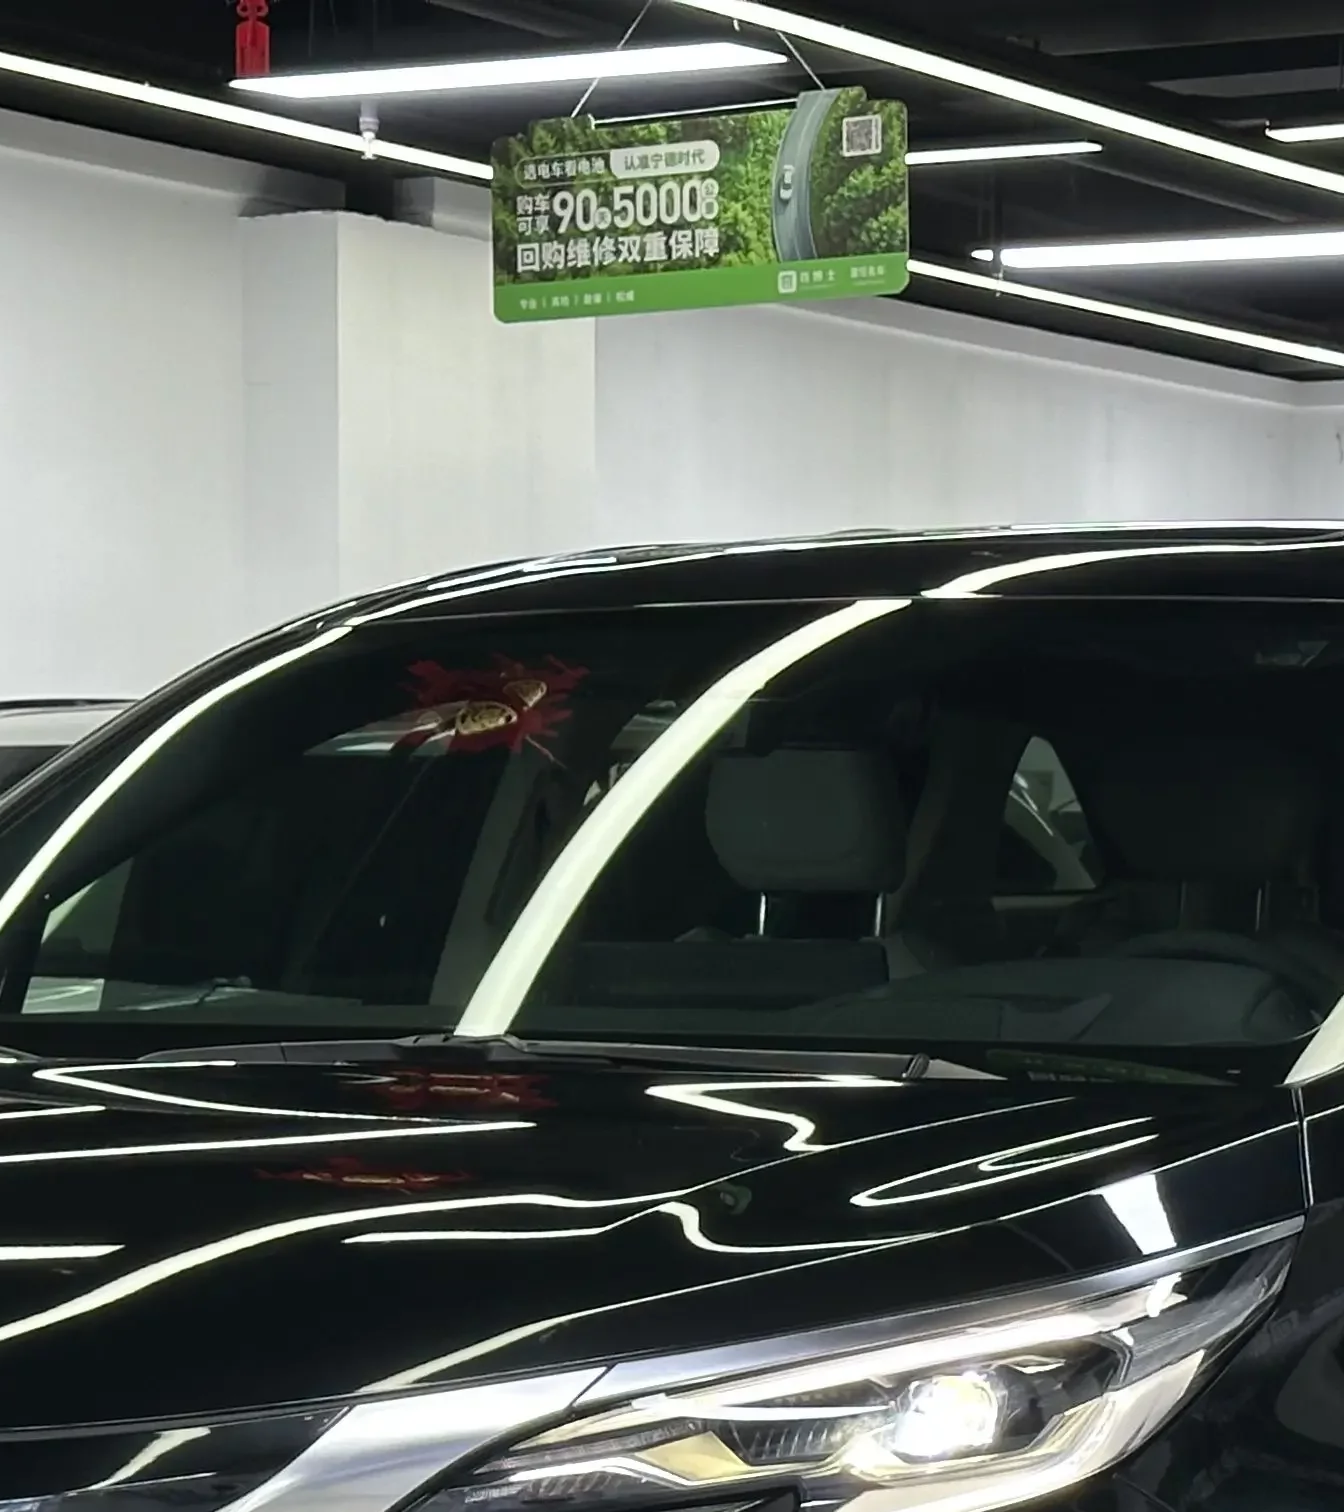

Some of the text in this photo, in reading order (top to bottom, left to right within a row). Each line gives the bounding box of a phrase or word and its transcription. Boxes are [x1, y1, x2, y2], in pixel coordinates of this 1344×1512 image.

[516, 226, 720, 273] 回购维修双重保障
